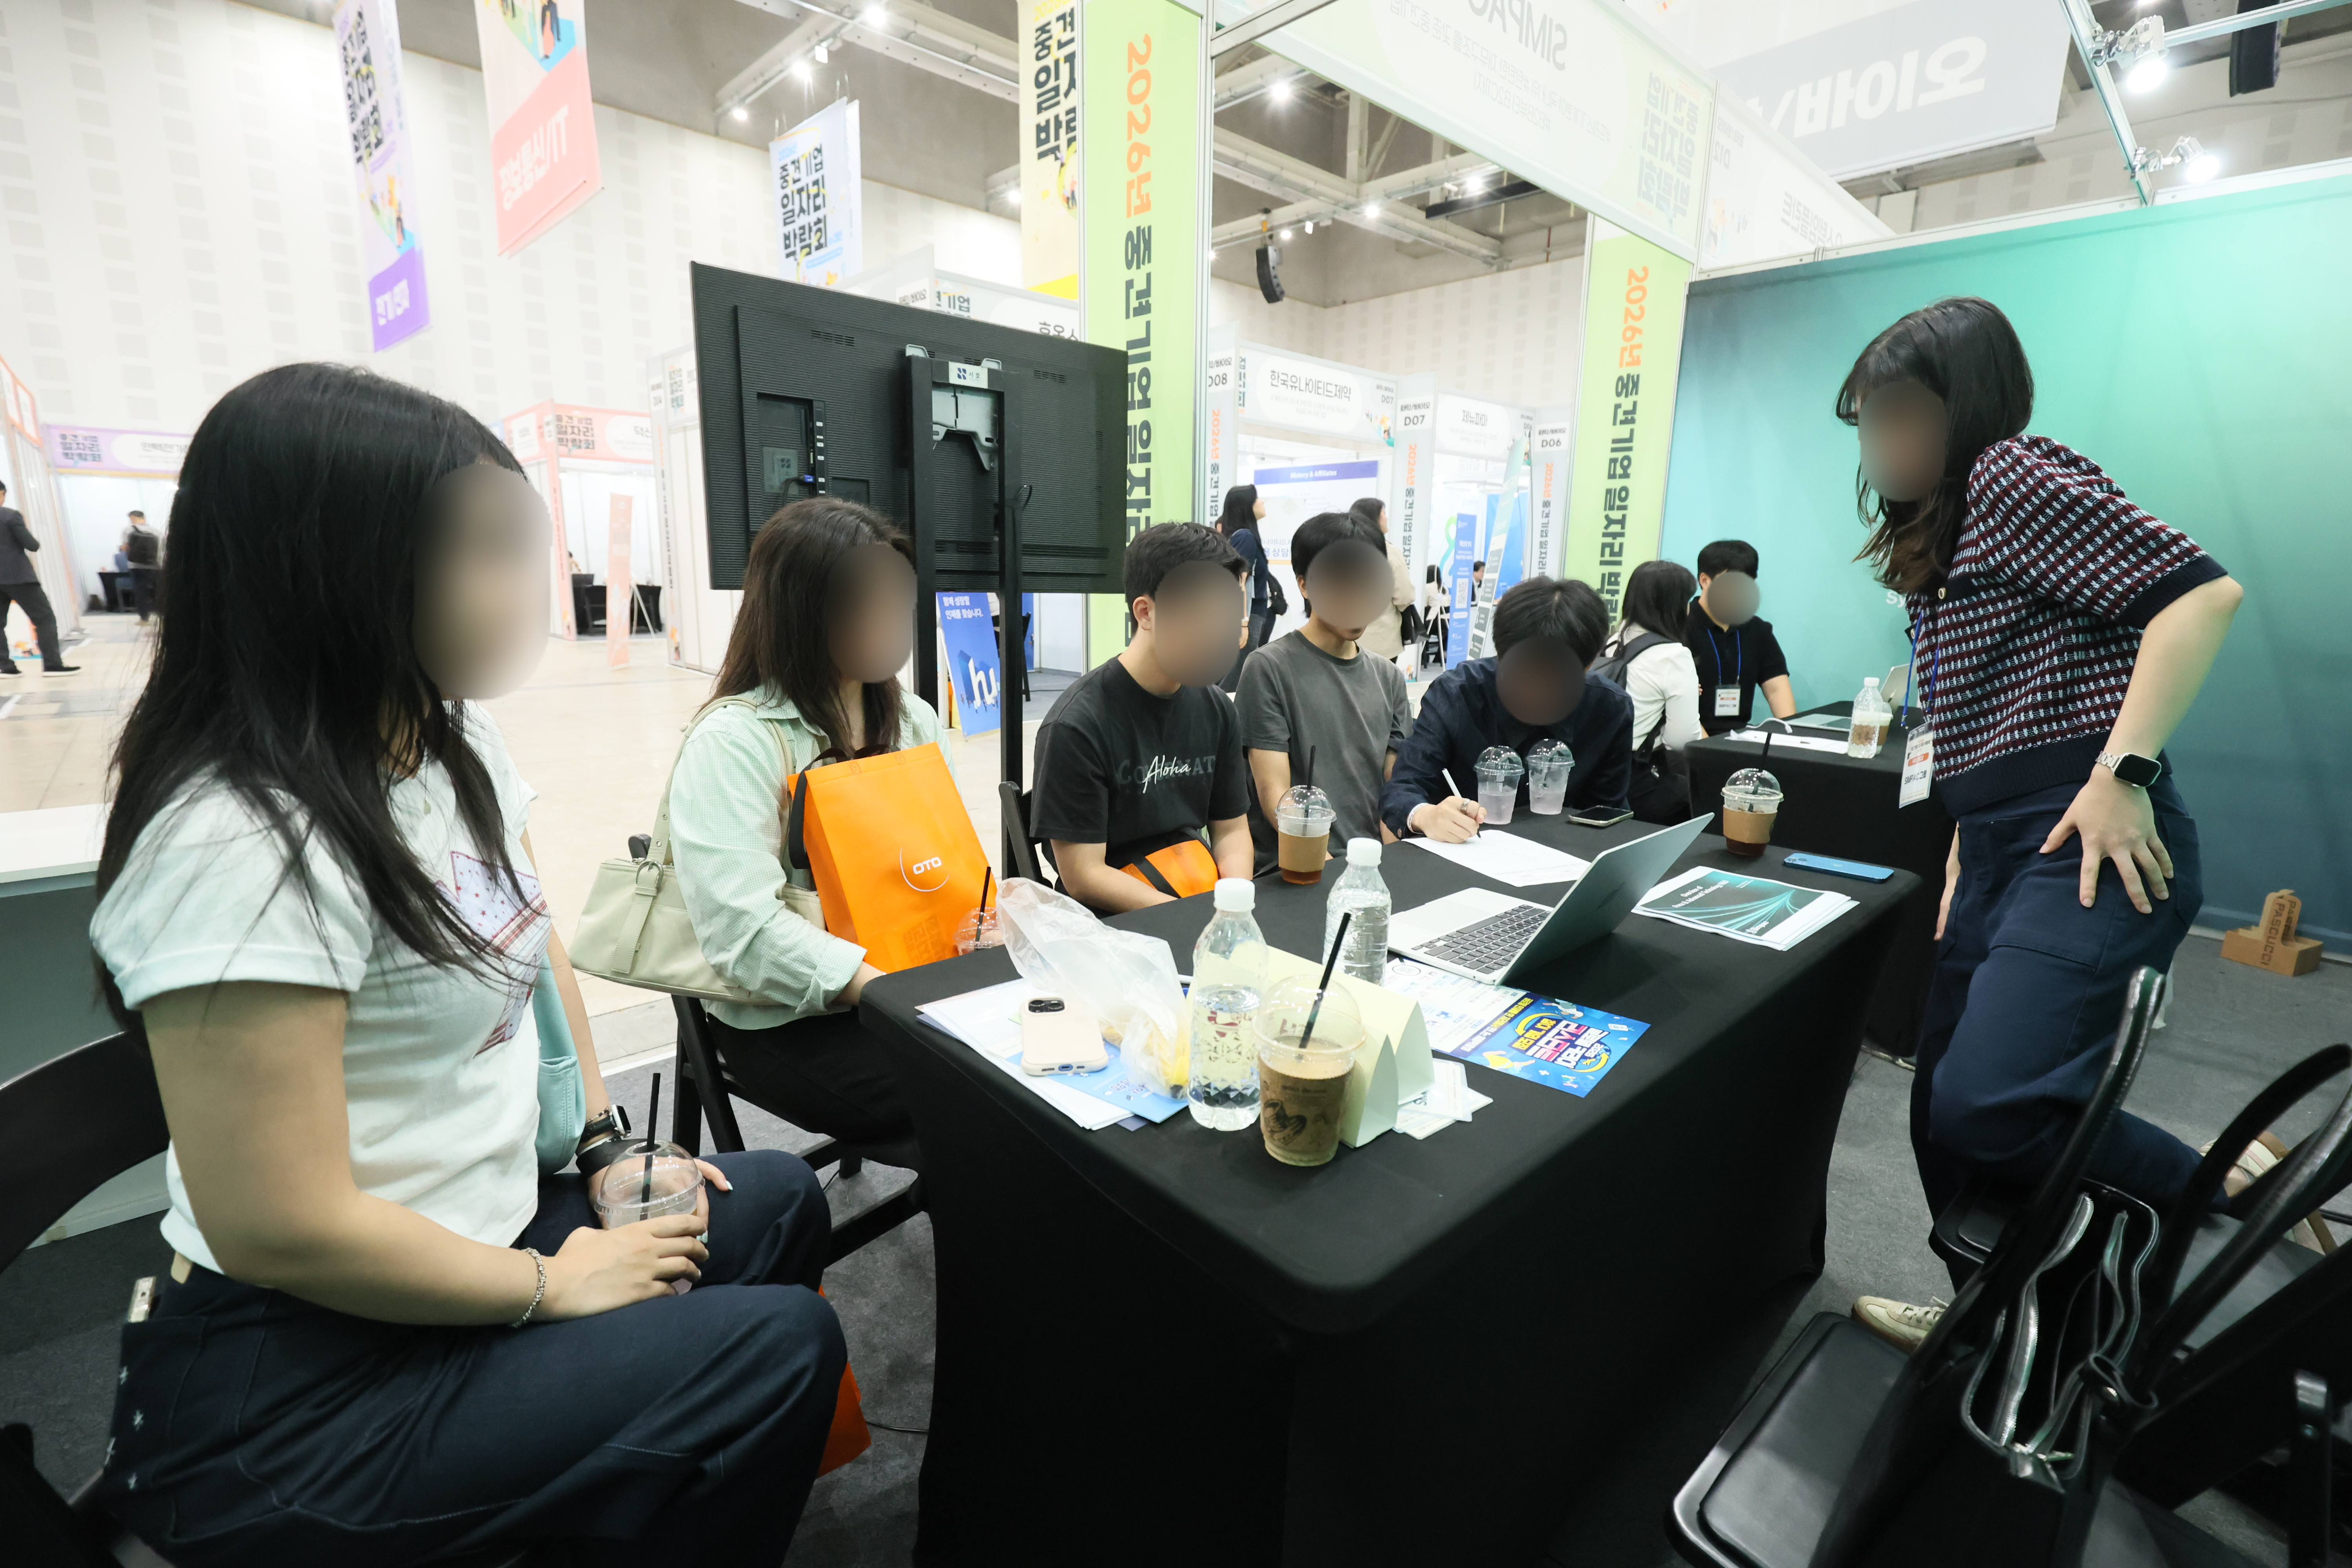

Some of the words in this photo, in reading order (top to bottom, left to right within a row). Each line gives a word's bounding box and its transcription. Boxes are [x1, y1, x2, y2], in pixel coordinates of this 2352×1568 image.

[1126, 34, 1152, 218] 2026년
[779, 143, 824, 190] 중견기업
[781, 174, 825, 226] 일자리
[783, 215, 828, 265] 박람회
[1125, 225, 1152, 410] 중견기업
[1619, 266, 1649, 367] 2026년
[1270, 369, 1352, 402] 한국유나이티드제약
[1382, 395, 1393, 405] D07
[556, 424, 593, 437] 일자리
[1211, 409, 1220, 459] 2026년
[1404, 415, 1425, 426] D07
[1463, 410, 1488, 426] 제뉴파마
[1607, 373, 1640, 479] 중견기업
[1541, 438, 1562, 448] D06
[1290, 471, 1308, 479] History
[1406, 443, 1417, 485] 2026년
[1543, 463, 1553, 498] 2026년
[1210, 462, 1220, 517] 중견기업
[1403, 487, 1415, 533] 중견기업
[1541, 500, 1551, 538] 중견기업
[1599, 486, 1629, 566] 일자리
[1538, 540, 1548, 570] 일자리
[942, 597, 954, 606] 함께
[955, 596, 970, 606] 성장할
[945, 609, 962, 619] 인재를
[962, 608, 984, 618] 찾습니다.
[1142, 755, 1191, 793] Aloha
[913, 856, 942, 875] OTO
[1681, 888, 1699, 897] Overview
[2261, 902, 2285, 965] PASCUCCI
[1522, 1027, 1546, 1040] 기업
[1523, 1020, 1589, 1062] 리스타트
[1534, 1018, 1559, 1031] 참여
[1573, 1027, 1610, 1049] 글로벌
[1510, 1036, 1535, 1050] 모집
[1552, 1045, 1591, 1069] 커리어
[1583, 1043, 1604, 1058] 2026
